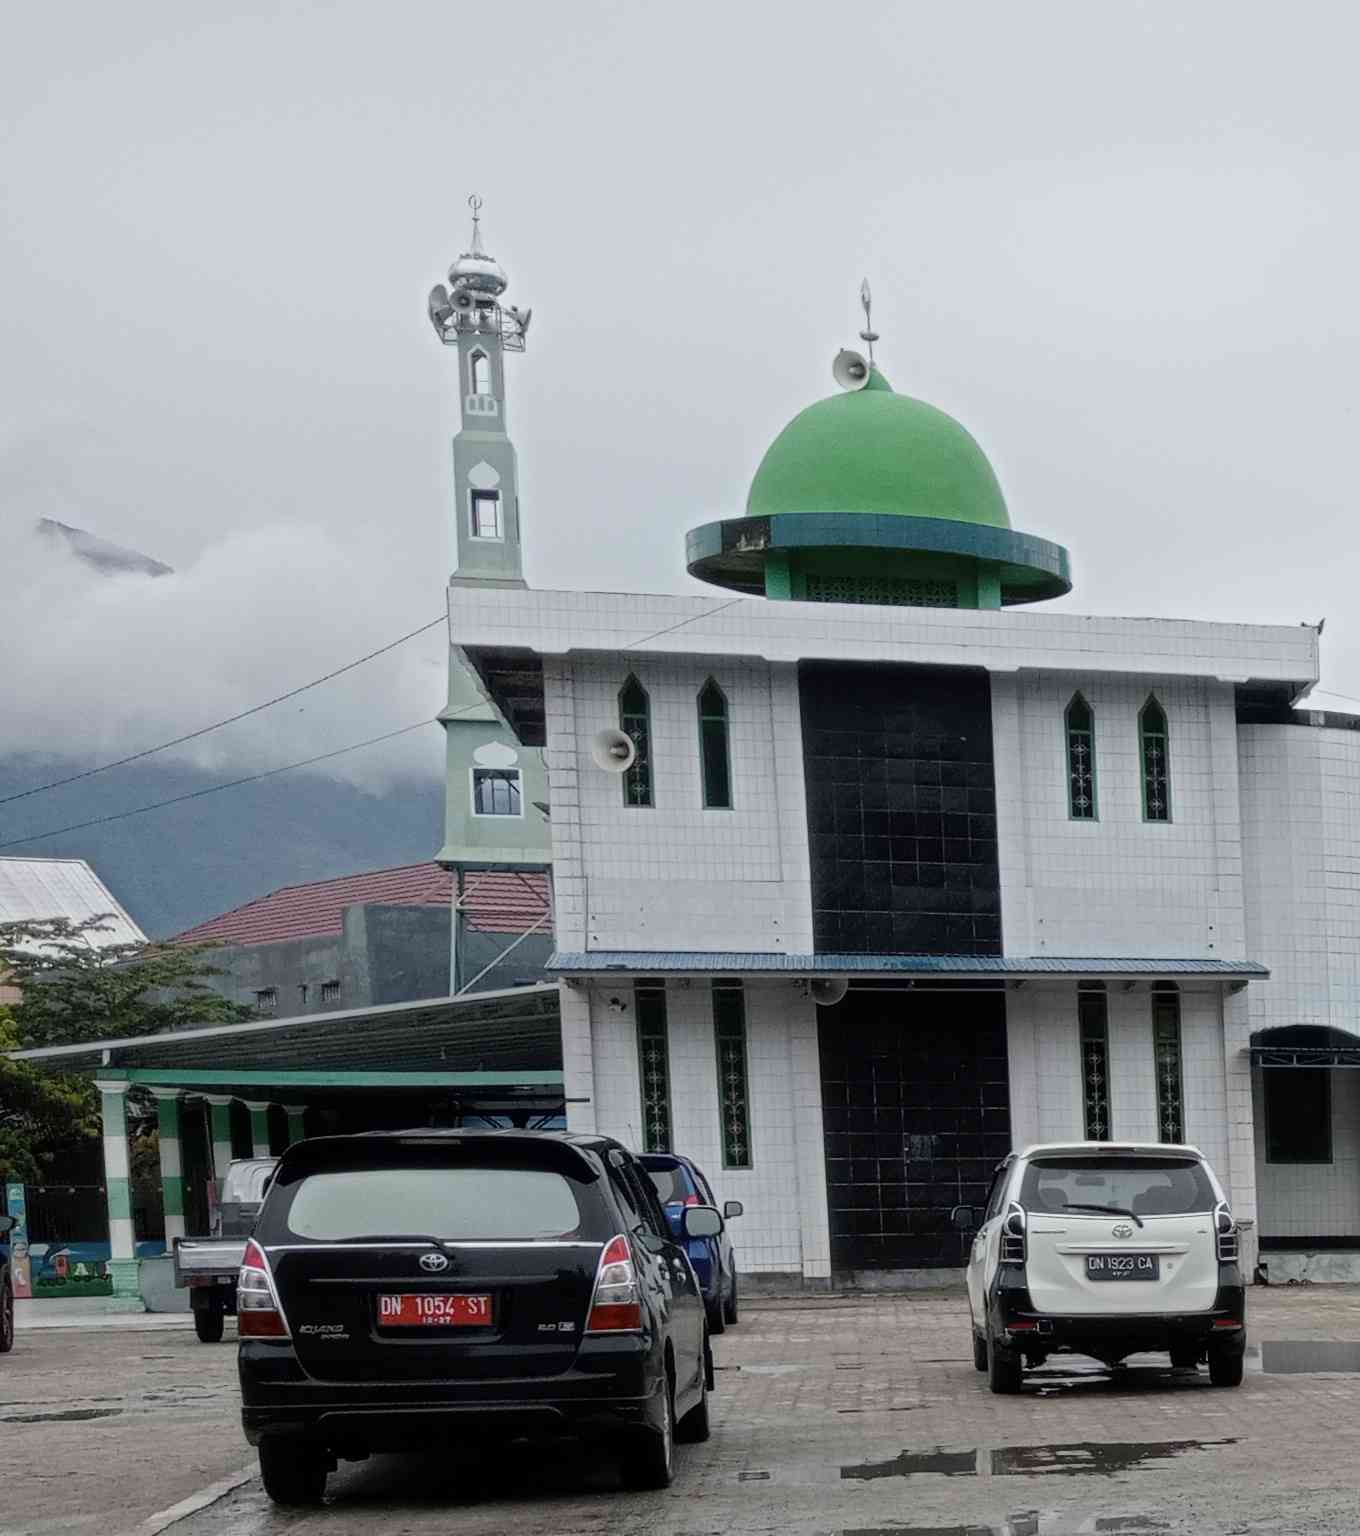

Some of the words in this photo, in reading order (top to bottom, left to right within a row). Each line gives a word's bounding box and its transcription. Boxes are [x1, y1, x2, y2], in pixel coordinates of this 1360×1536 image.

[381, 1297, 401, 1315] DN
[416, 1296, 455, 1315] 1054
[466, 1297, 487, 1315] ST
